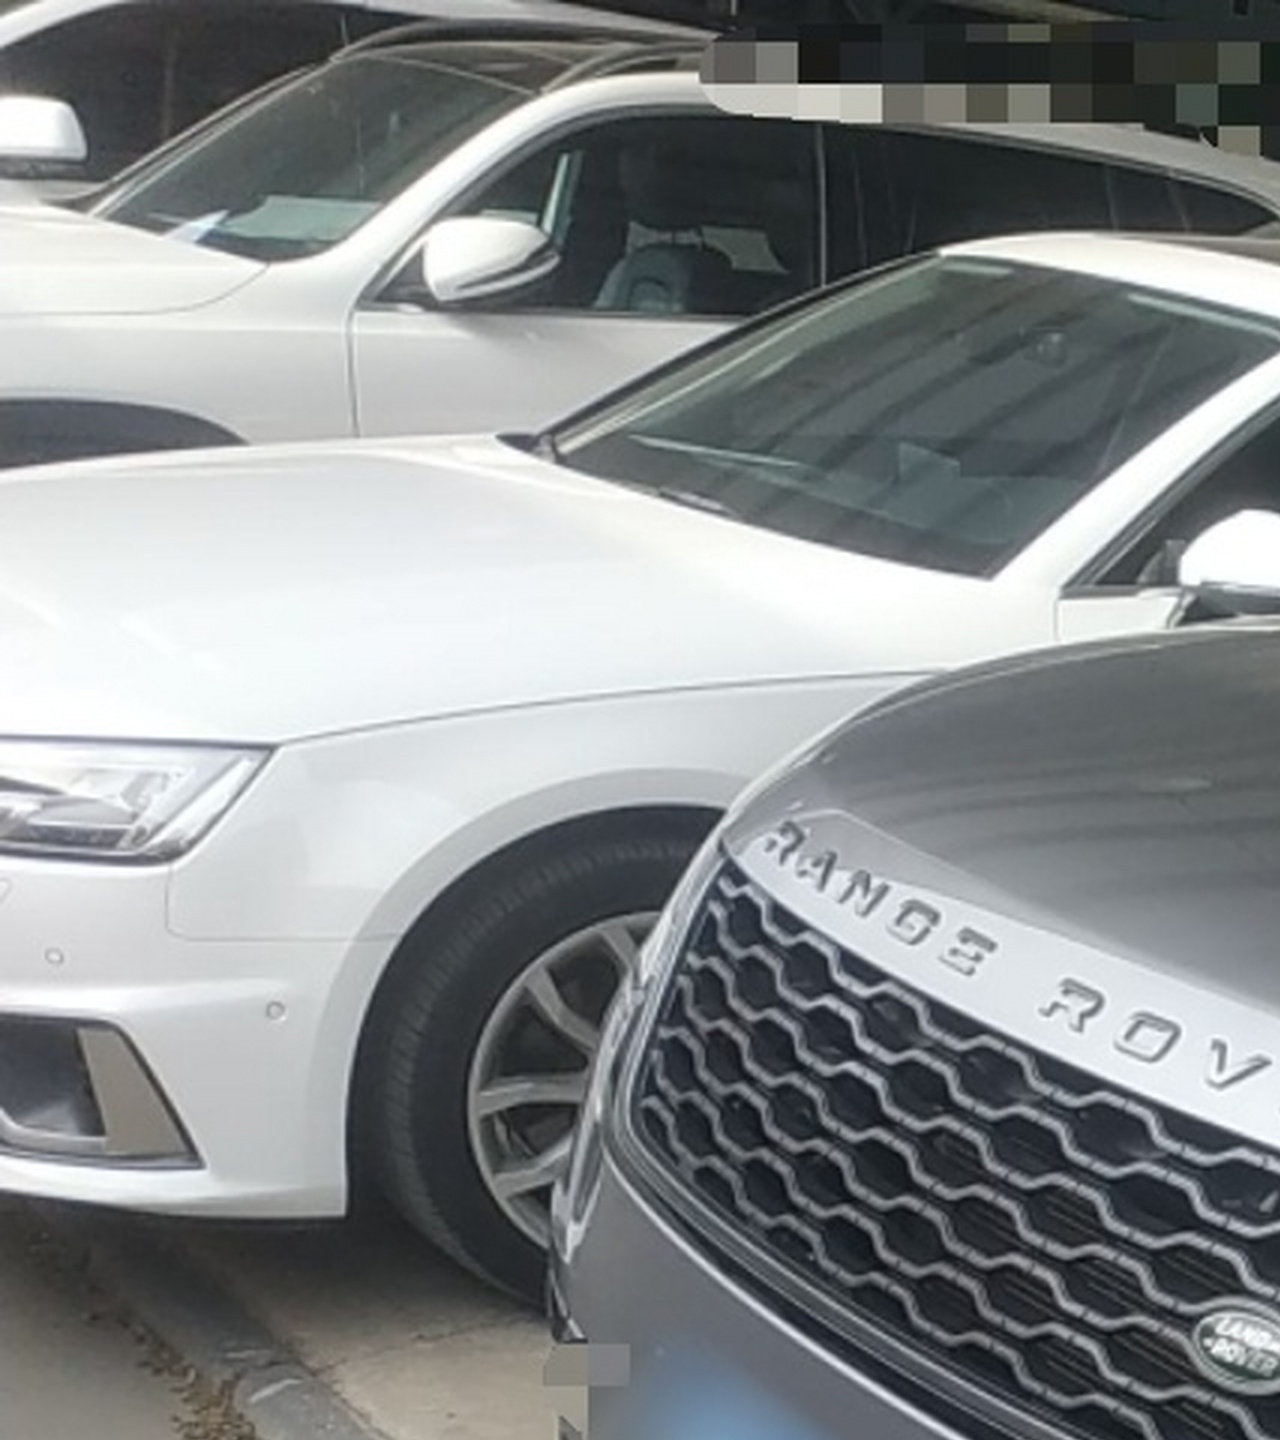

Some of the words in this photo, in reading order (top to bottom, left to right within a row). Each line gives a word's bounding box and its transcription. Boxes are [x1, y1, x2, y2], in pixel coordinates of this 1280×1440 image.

[762, 819, 999, 978] RANGE
[1214, 1316, 1274, 1349] LAND
[1209, 1337, 1279, 1378] ROVER
